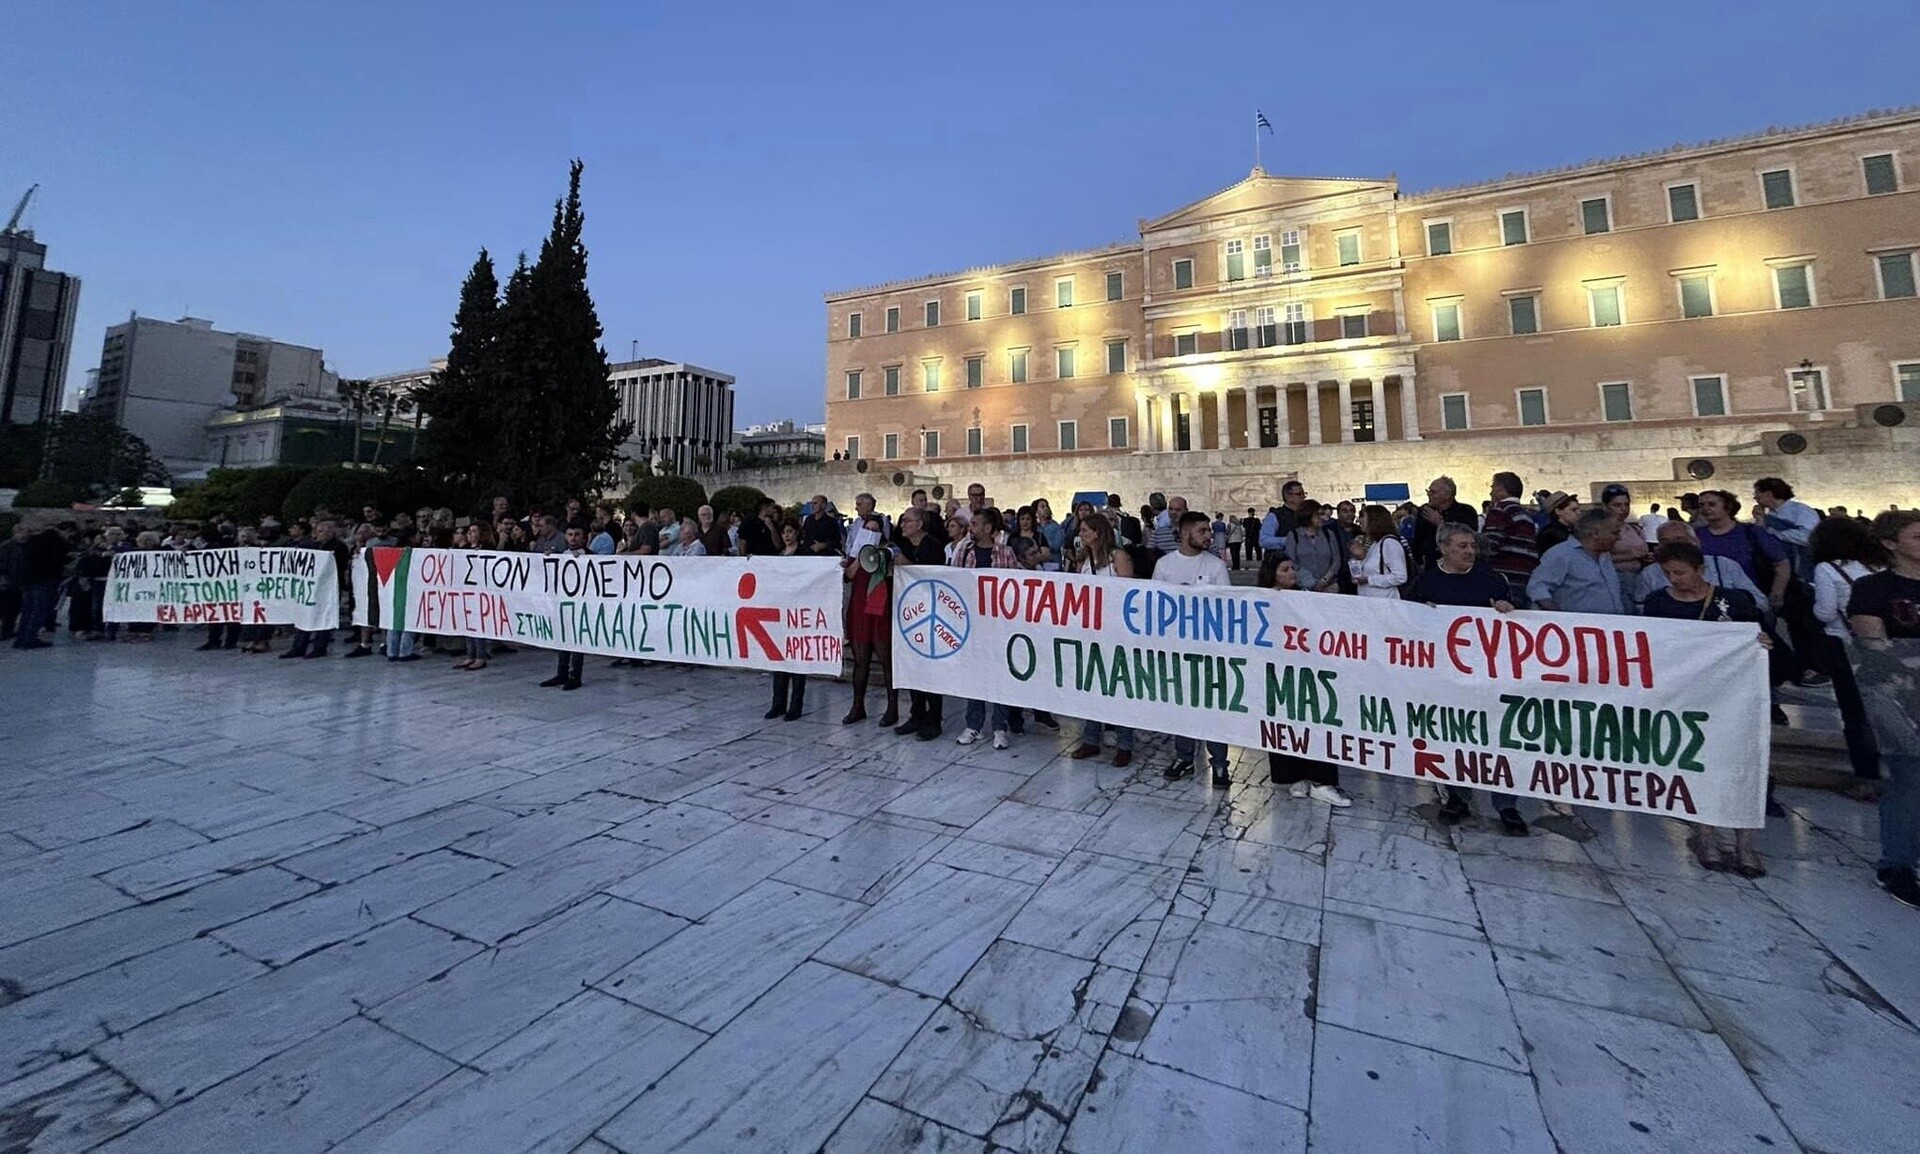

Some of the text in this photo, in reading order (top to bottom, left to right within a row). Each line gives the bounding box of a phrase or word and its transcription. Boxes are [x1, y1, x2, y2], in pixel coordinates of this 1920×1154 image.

[153, 549, 240, 579] ΣΥΜΜΕΤΟΧΗ
[421, 554, 673, 600] ΟΧΙ ΣΤΟΝ ΠΟΛΕΜΟ
[416, 591, 732, 660] ΛΕΥΤΕΡΙΑ ΣΤΗΝ ΠΑΛΑΙΣΤΙΝΗ
[786, 607, 828, 630] ΝΕΑ
[902, 602, 926, 621] Give
[785, 634, 842, 663] ΑΡΙΣΤΕΡΑ
[914, 632, 924, 644] a
[934, 623, 961, 651] chance
[978, 575, 1655, 689] ΠΟΤΑΜΙ ΕΙΡΗΝΗΣ ΣΕ ΟΛΗ ΤΗΝ ΕΥΡΩΠΗ
[1006, 632, 1710, 773] Ο ΠΛΑΝΗΤΗΣ ΜΑΣ ΝΑ ΜΕΙΝΕΙ ΖΩΝΤΑΝΟΣ
[1260, 719, 1397, 771] NEW LEFT
[1454, 748, 1698, 815] ΝΕΑ ΑΡΙΣΤΕΡΑ
